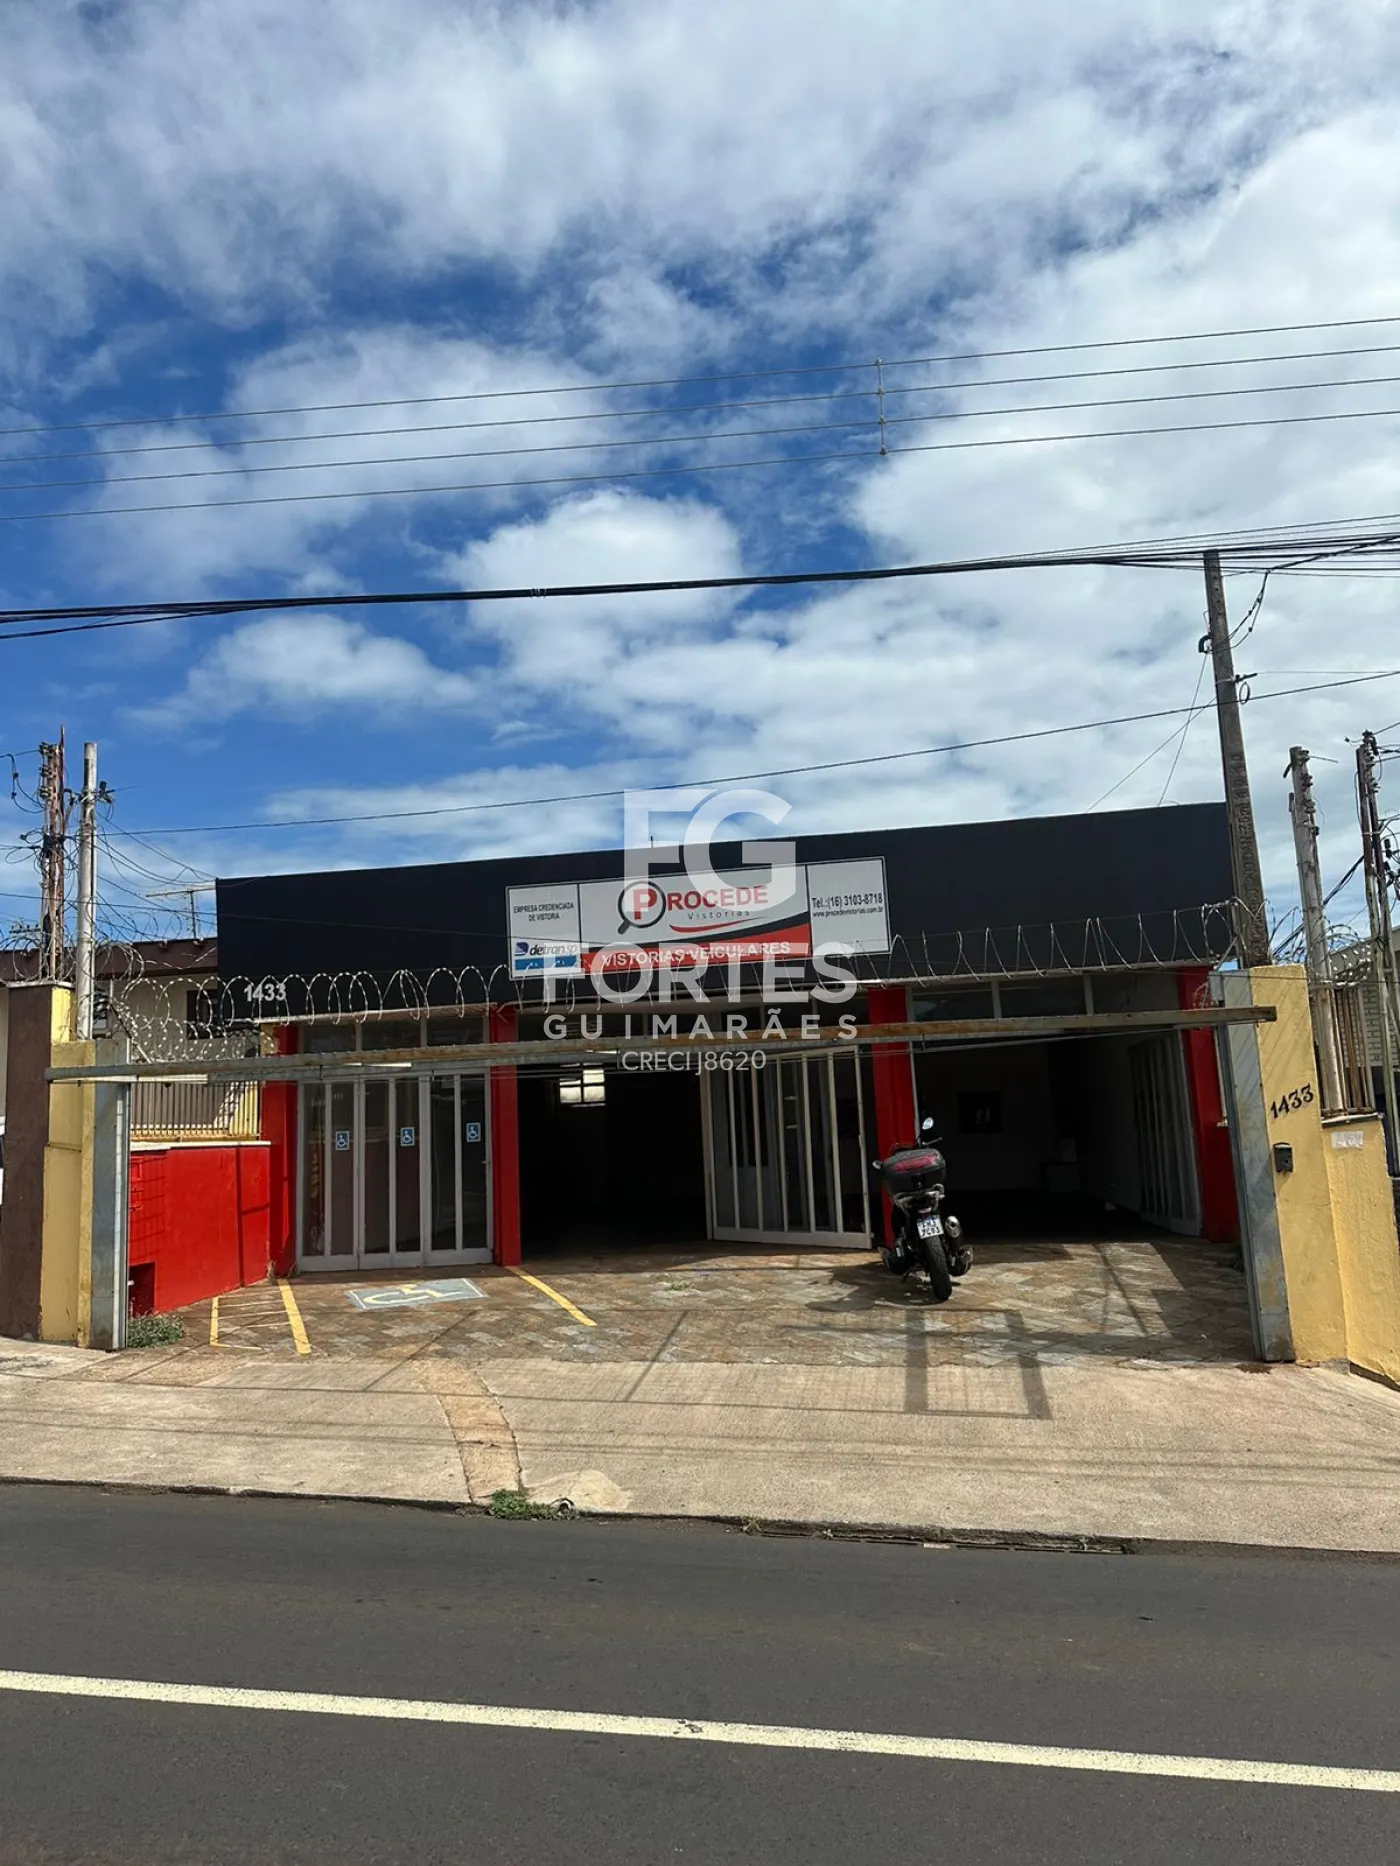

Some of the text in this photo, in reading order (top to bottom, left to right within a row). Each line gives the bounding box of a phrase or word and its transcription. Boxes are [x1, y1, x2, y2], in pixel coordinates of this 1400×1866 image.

[513, 901, 574, 913] EMPRESA CREDENCIADA
[537, 912, 561, 920] VISTORIA
[687, 910, 750, 920] Vistorias
[602, 941, 791, 967] VISTORIAS VEICULARES
[244, 983, 286, 1002] 1433
[1270, 1083, 1314, 1118] 1433
